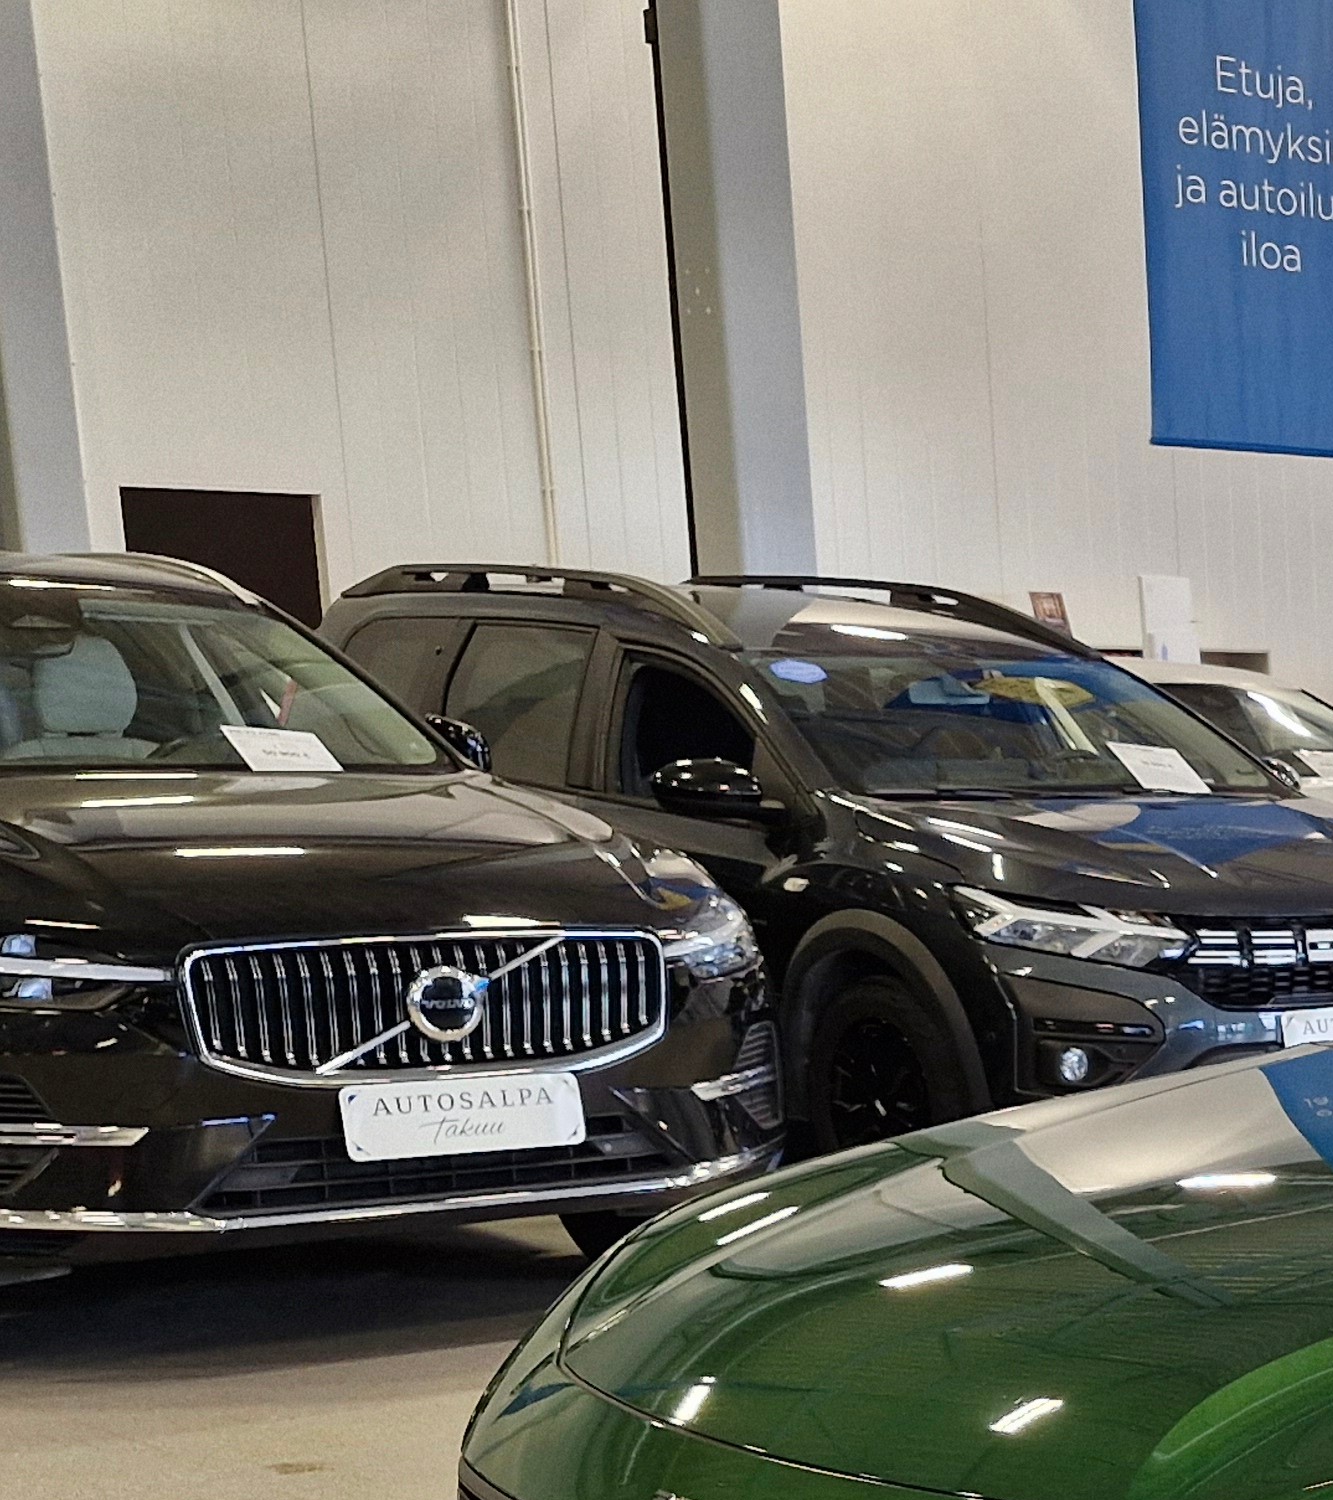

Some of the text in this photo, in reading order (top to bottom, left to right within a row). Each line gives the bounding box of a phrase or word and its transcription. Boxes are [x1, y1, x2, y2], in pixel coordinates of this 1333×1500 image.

[1215, 54, 1314, 110] Etuja,
[1175, 163, 1206, 209] ja
[1241, 229, 1302, 274] iloa
[420, 998, 476, 1010] VOLVO
[372, 1086, 554, 1117] AUTOSALPA
[418, 1115, 506, 1146] Takuu
